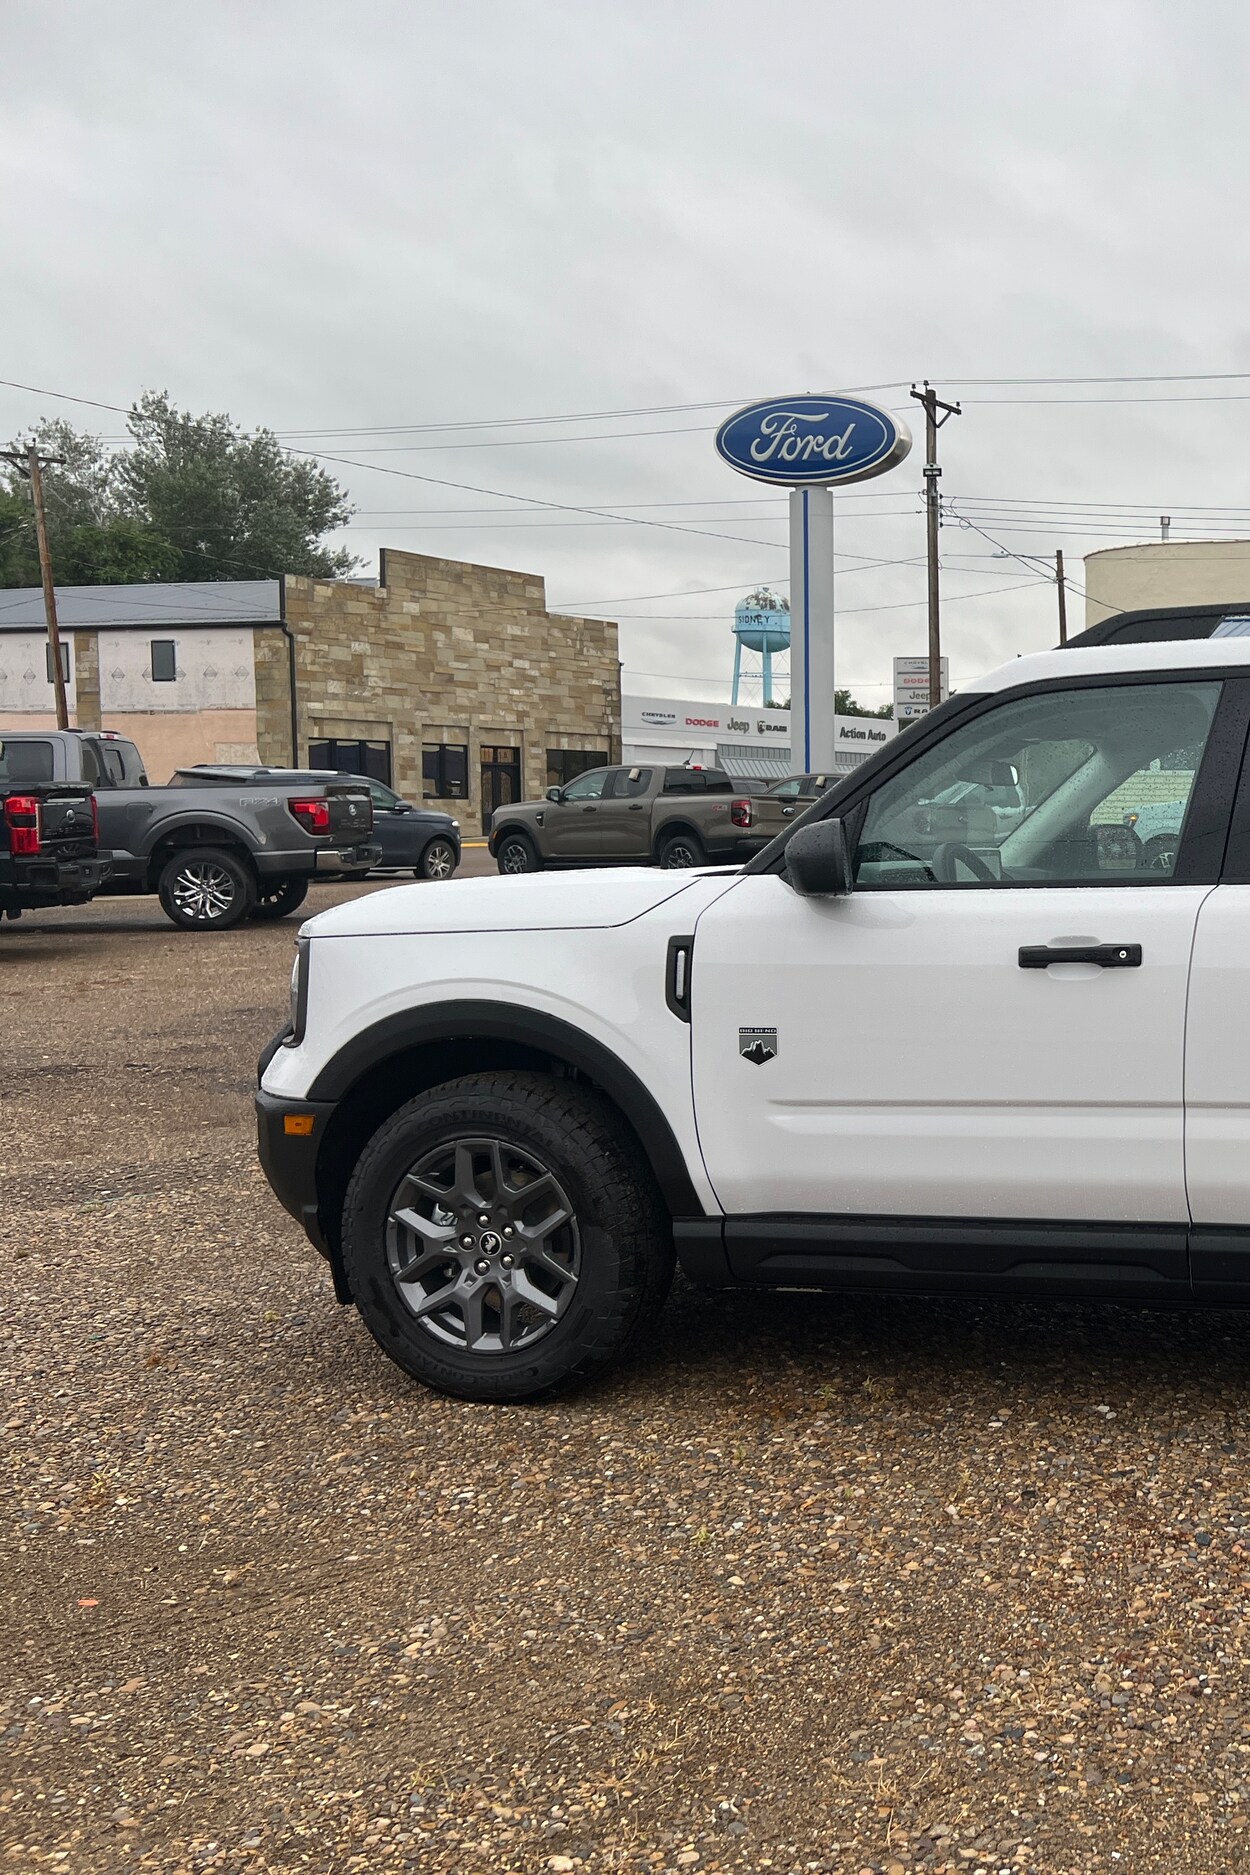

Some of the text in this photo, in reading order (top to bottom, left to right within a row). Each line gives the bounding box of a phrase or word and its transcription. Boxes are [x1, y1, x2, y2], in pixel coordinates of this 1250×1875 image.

[750, 412, 856, 462] Ford
[738, 614, 770, 626] SIDNEY
[641, 711, 676, 719] CHRYSLER
[685, 718, 719, 728] DODGE
[727, 717, 750, 734] Jeep
[766, 724, 788, 733] RAM
[840, 726, 887, 741] Action Auto
